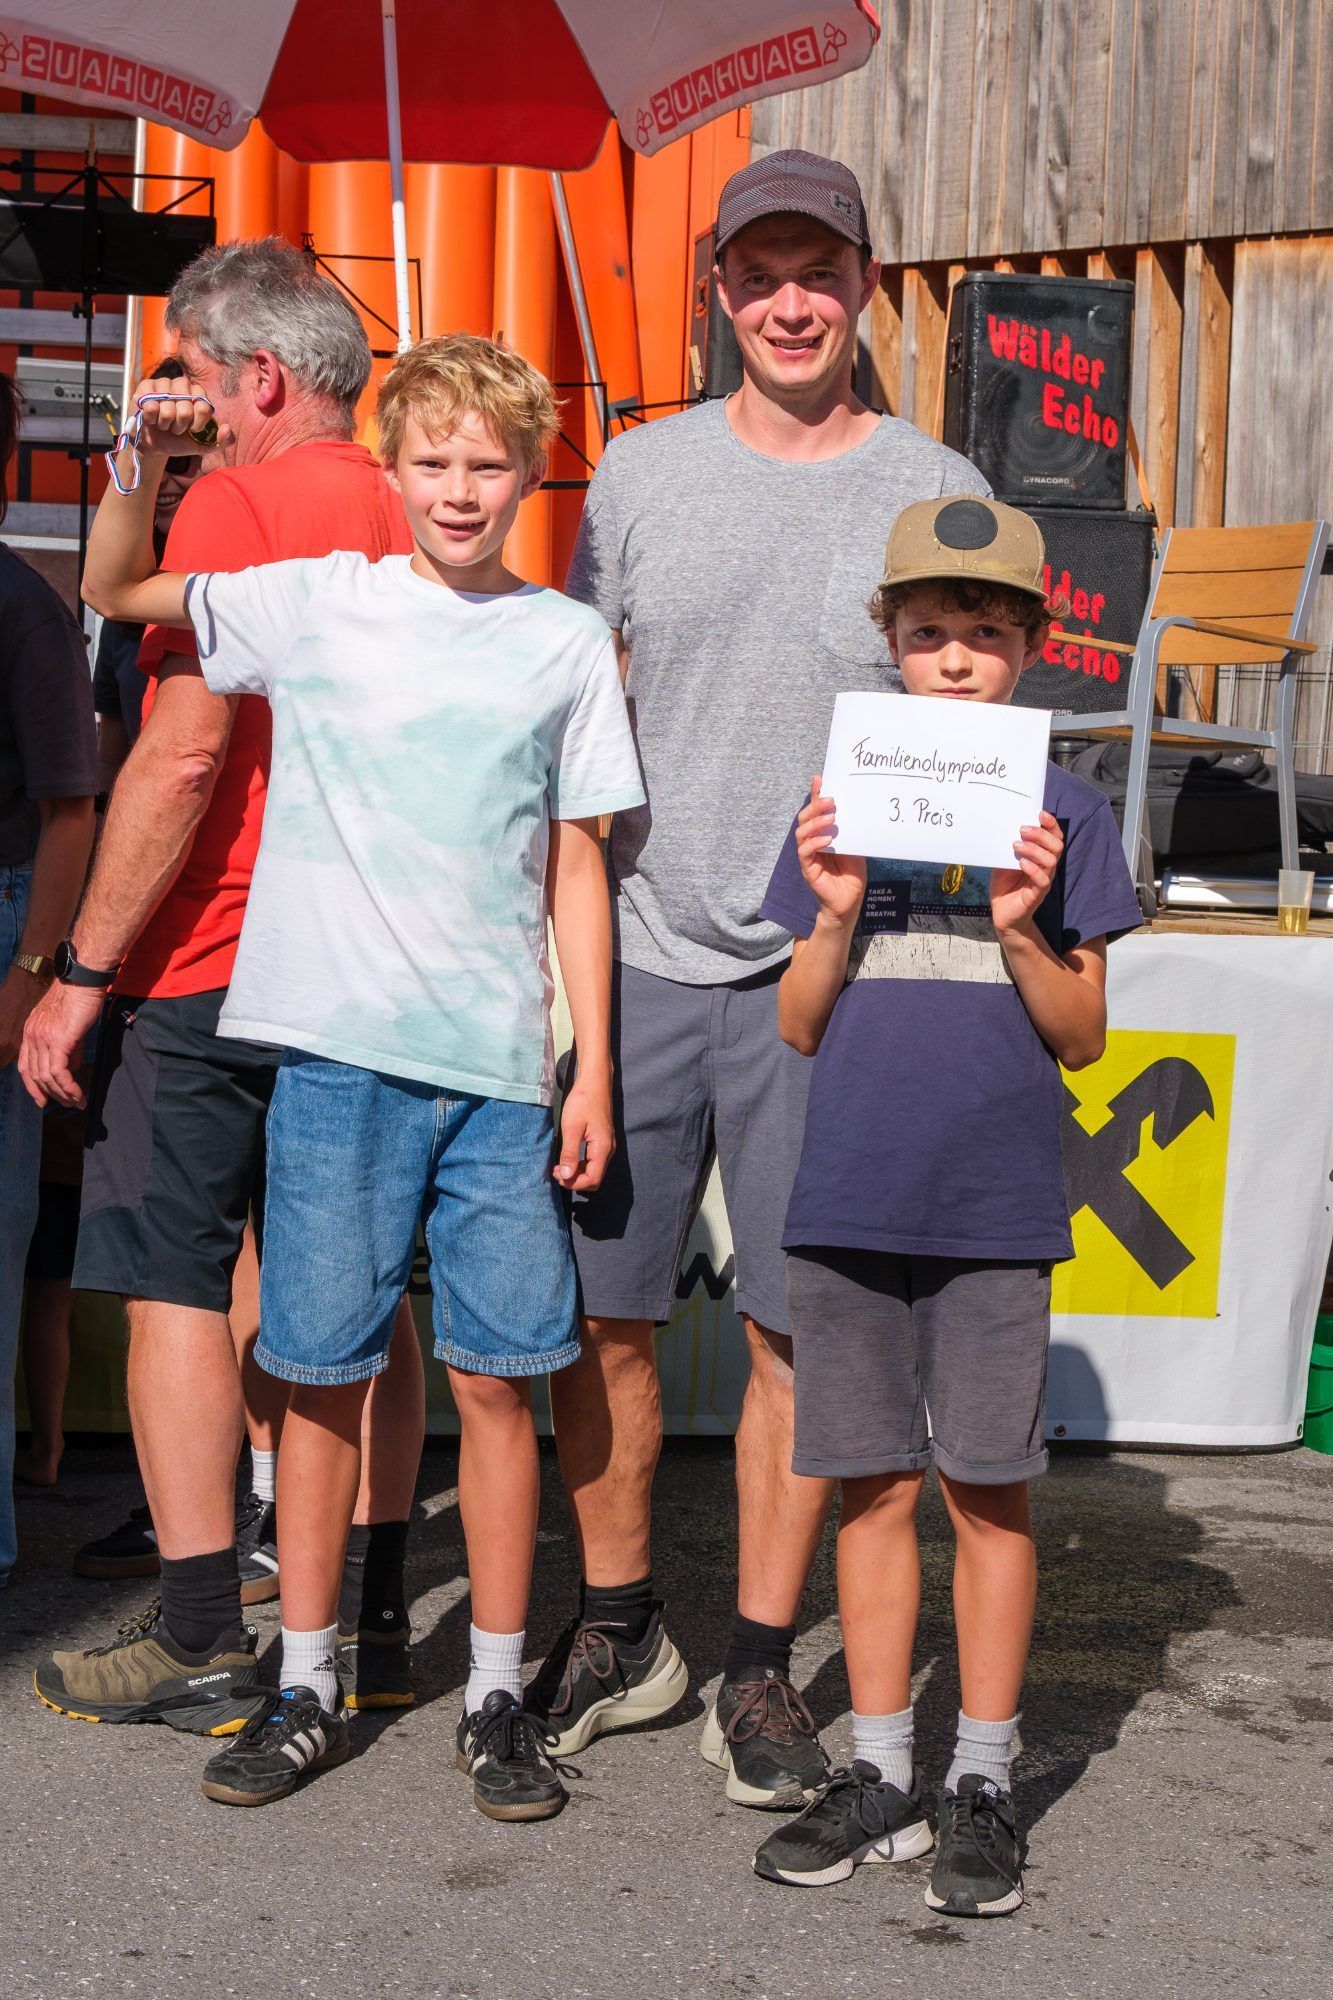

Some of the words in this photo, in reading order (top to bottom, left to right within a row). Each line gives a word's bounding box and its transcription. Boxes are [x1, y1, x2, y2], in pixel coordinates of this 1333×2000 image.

[987, 314, 1105, 389] Wälder
[1042, 383, 1119, 448] Echo
[1043, 565, 1106, 624] lder
[851, 736, 1007, 783] Familienolympiade
[889, 797, 904, 823] 3.
[913, 797, 953, 827] Preis
[867, 895, 897, 903] MOMENT
[187, 1671, 232, 1687] SCARPA
